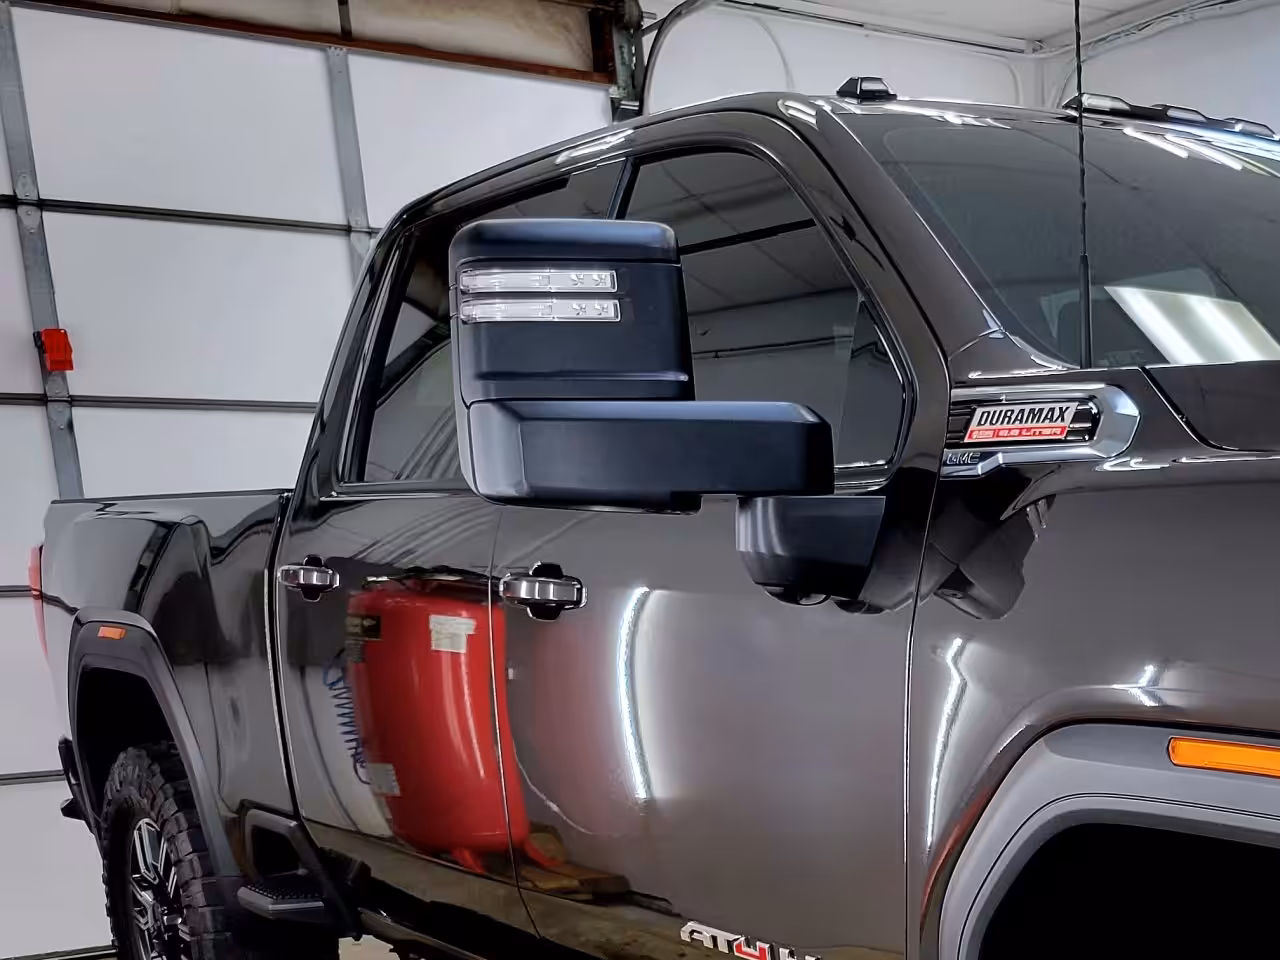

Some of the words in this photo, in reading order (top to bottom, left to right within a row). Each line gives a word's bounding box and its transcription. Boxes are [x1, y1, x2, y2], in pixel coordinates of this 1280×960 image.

[978, 407, 1070, 426] DURAMAX
[1023, 428, 1062, 436] LITER
[946, 452, 980, 465] GMC
